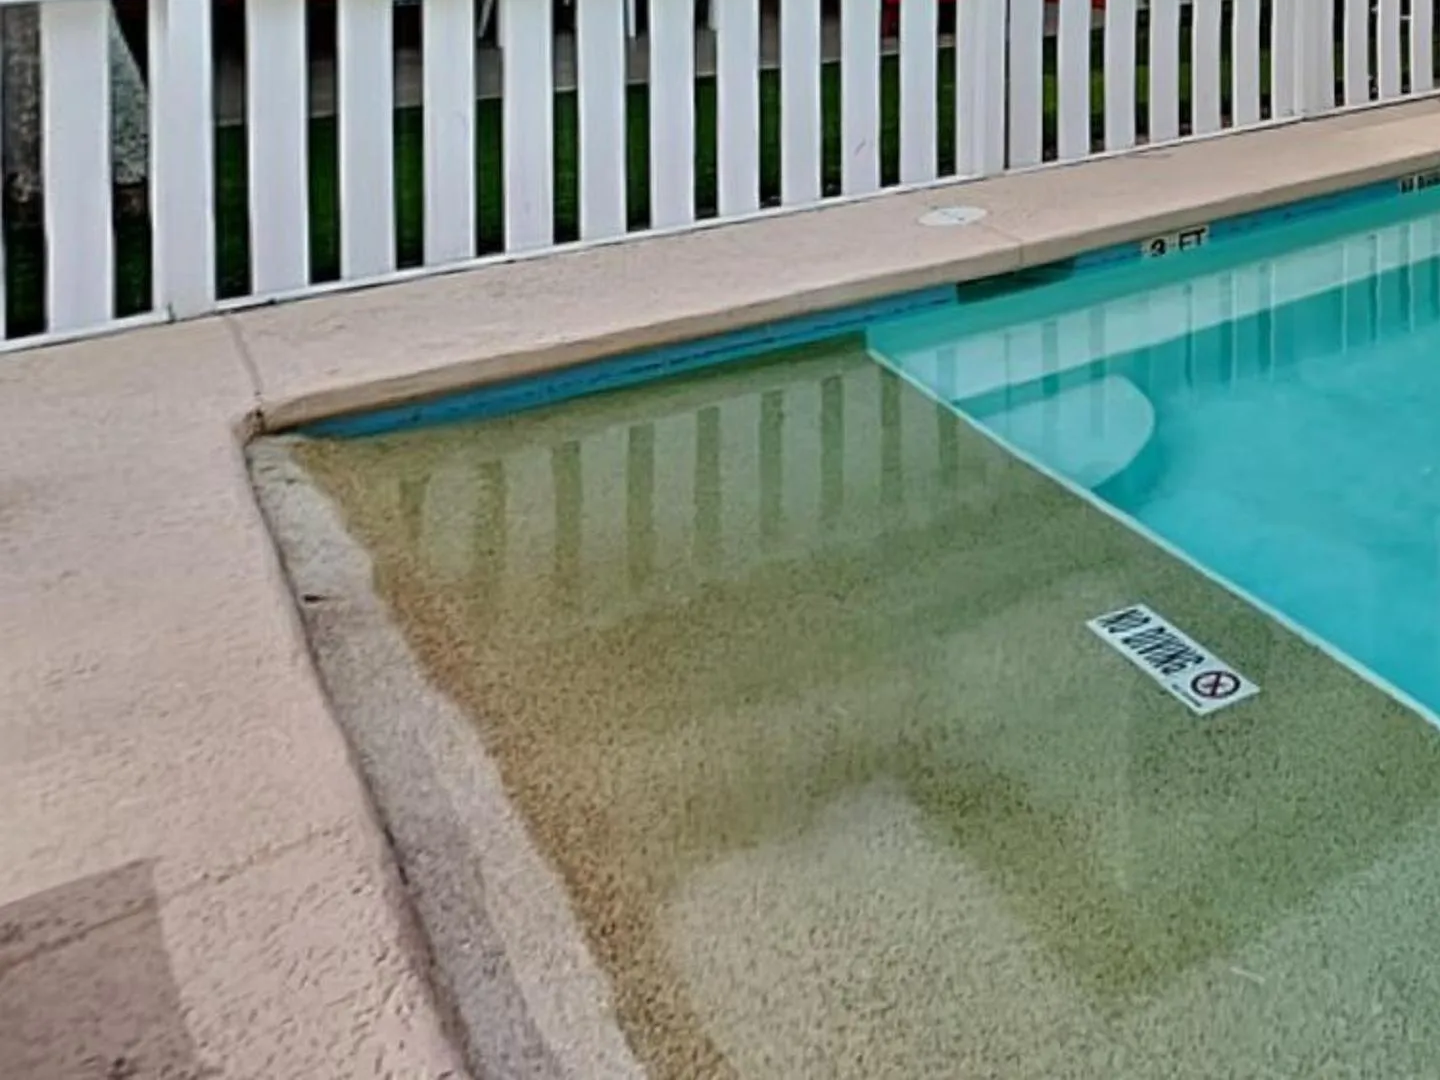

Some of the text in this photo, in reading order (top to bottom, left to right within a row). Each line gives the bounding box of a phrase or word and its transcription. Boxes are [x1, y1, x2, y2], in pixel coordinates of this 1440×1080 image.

[1179, 226, 1206, 251] FT
[1101, 608, 1205, 676] NO DIVING
